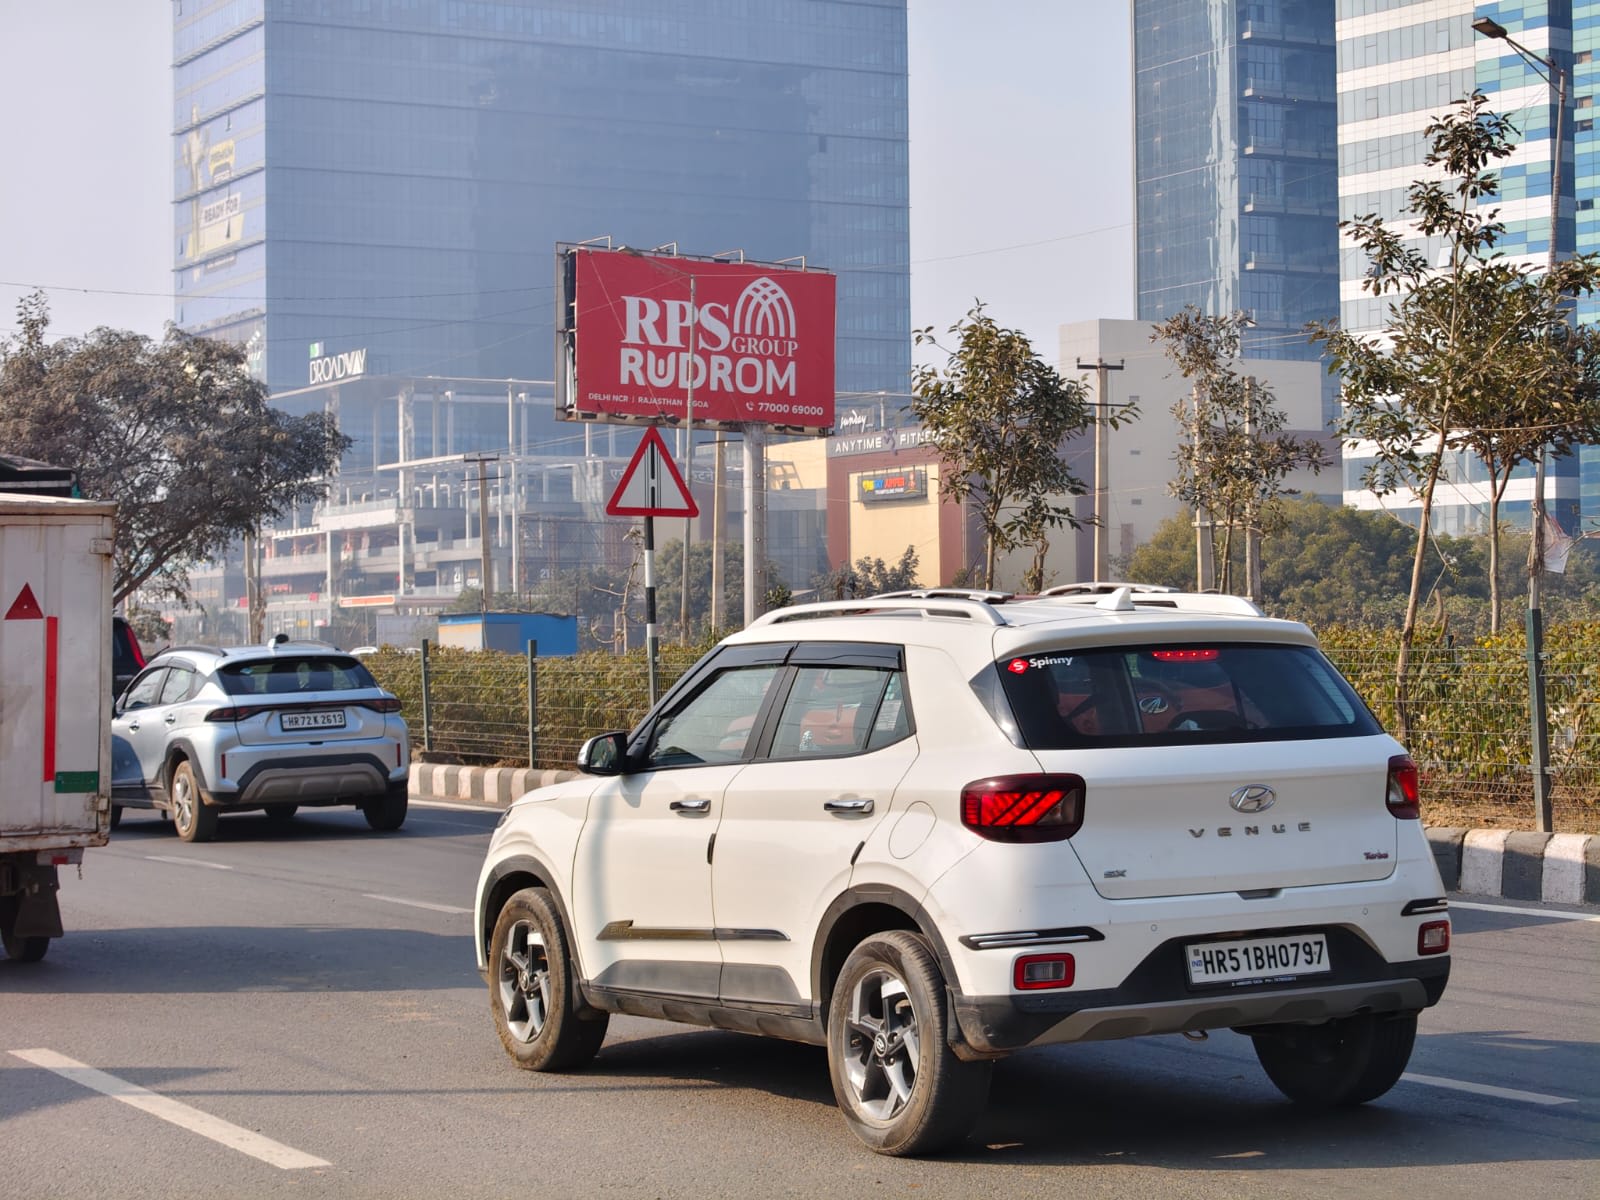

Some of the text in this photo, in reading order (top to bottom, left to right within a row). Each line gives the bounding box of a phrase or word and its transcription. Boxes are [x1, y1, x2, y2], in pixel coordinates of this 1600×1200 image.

[204, 197, 238, 223] READY FOR
[621, 295, 799, 357] RPS GROUP
[309, 348, 367, 385] BROADWAY
[620, 347, 796, 397] RUDROM
[588, 392, 709, 409] DELHI NCR RAJASTHAN GOA
[758, 402, 824, 416] 77000 69000
[835, 436, 882, 453] ANYTIME
[1029, 656, 1073, 669] Spinny
[1188, 822, 1311, 838] VENUE
[1202, 940, 1324, 975] HR51BH0797
